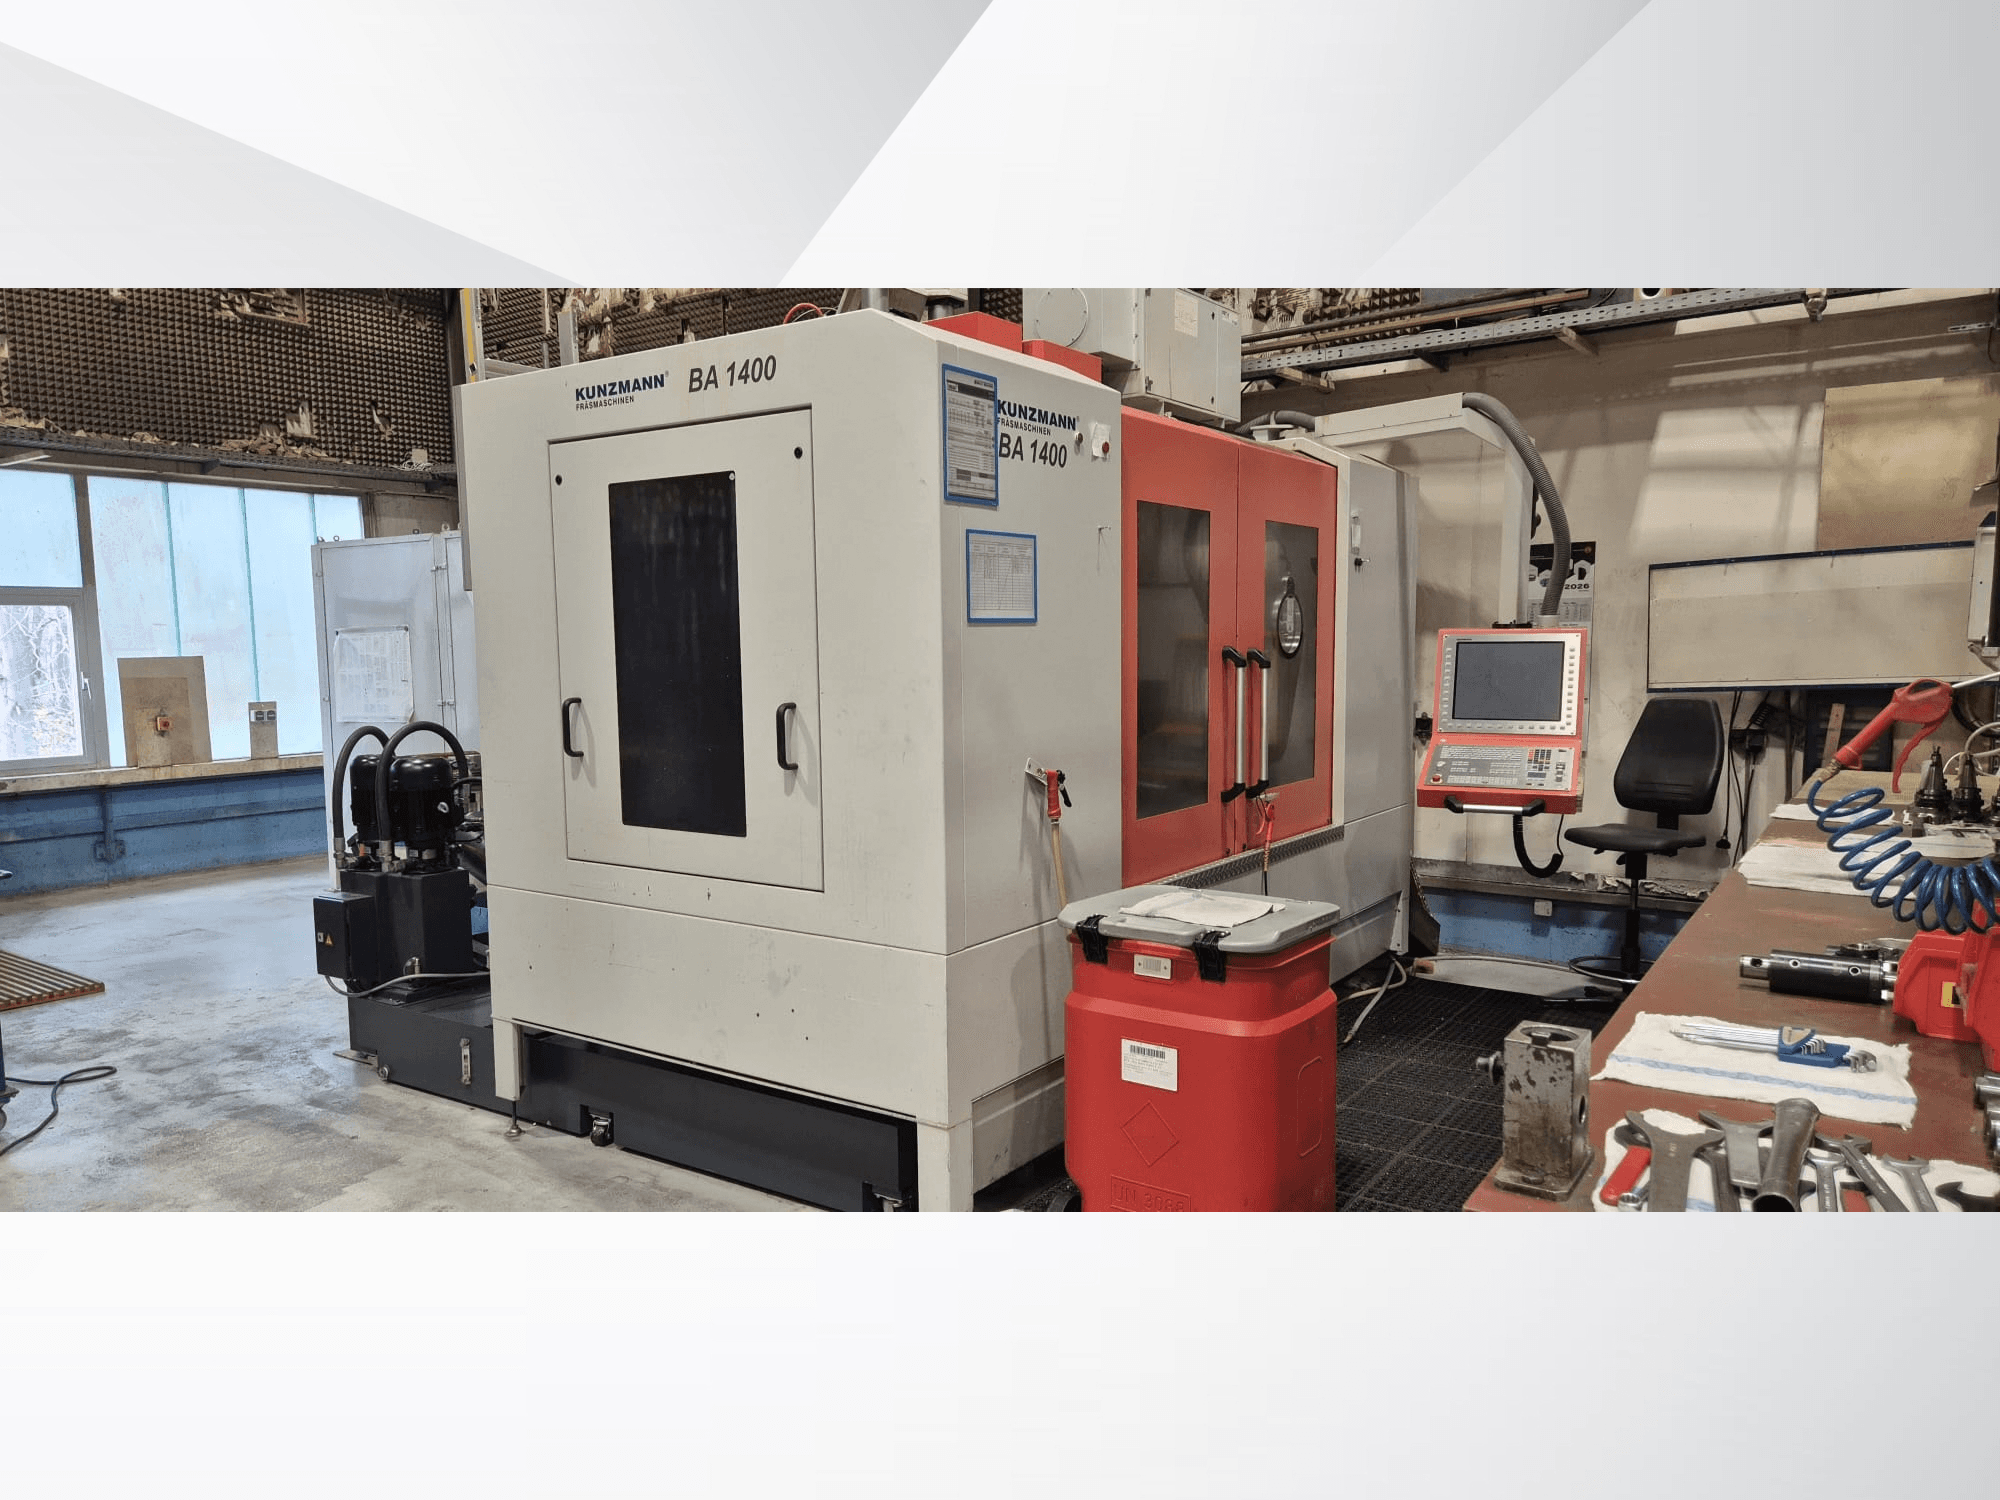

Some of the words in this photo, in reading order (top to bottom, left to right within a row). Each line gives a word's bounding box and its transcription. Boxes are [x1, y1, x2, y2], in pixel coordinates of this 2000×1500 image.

[575, 373, 665, 401] KUNZMANN
[689, 364, 719, 393] BA
[727, 354, 777, 387] 1400
[575, 395, 635, 411] FRÄSMASCHINEN
[997, 399, 1076, 431] KUNZMANN
[998, 432, 1024, 461] BA
[1030, 439, 1068, 468] 1400
